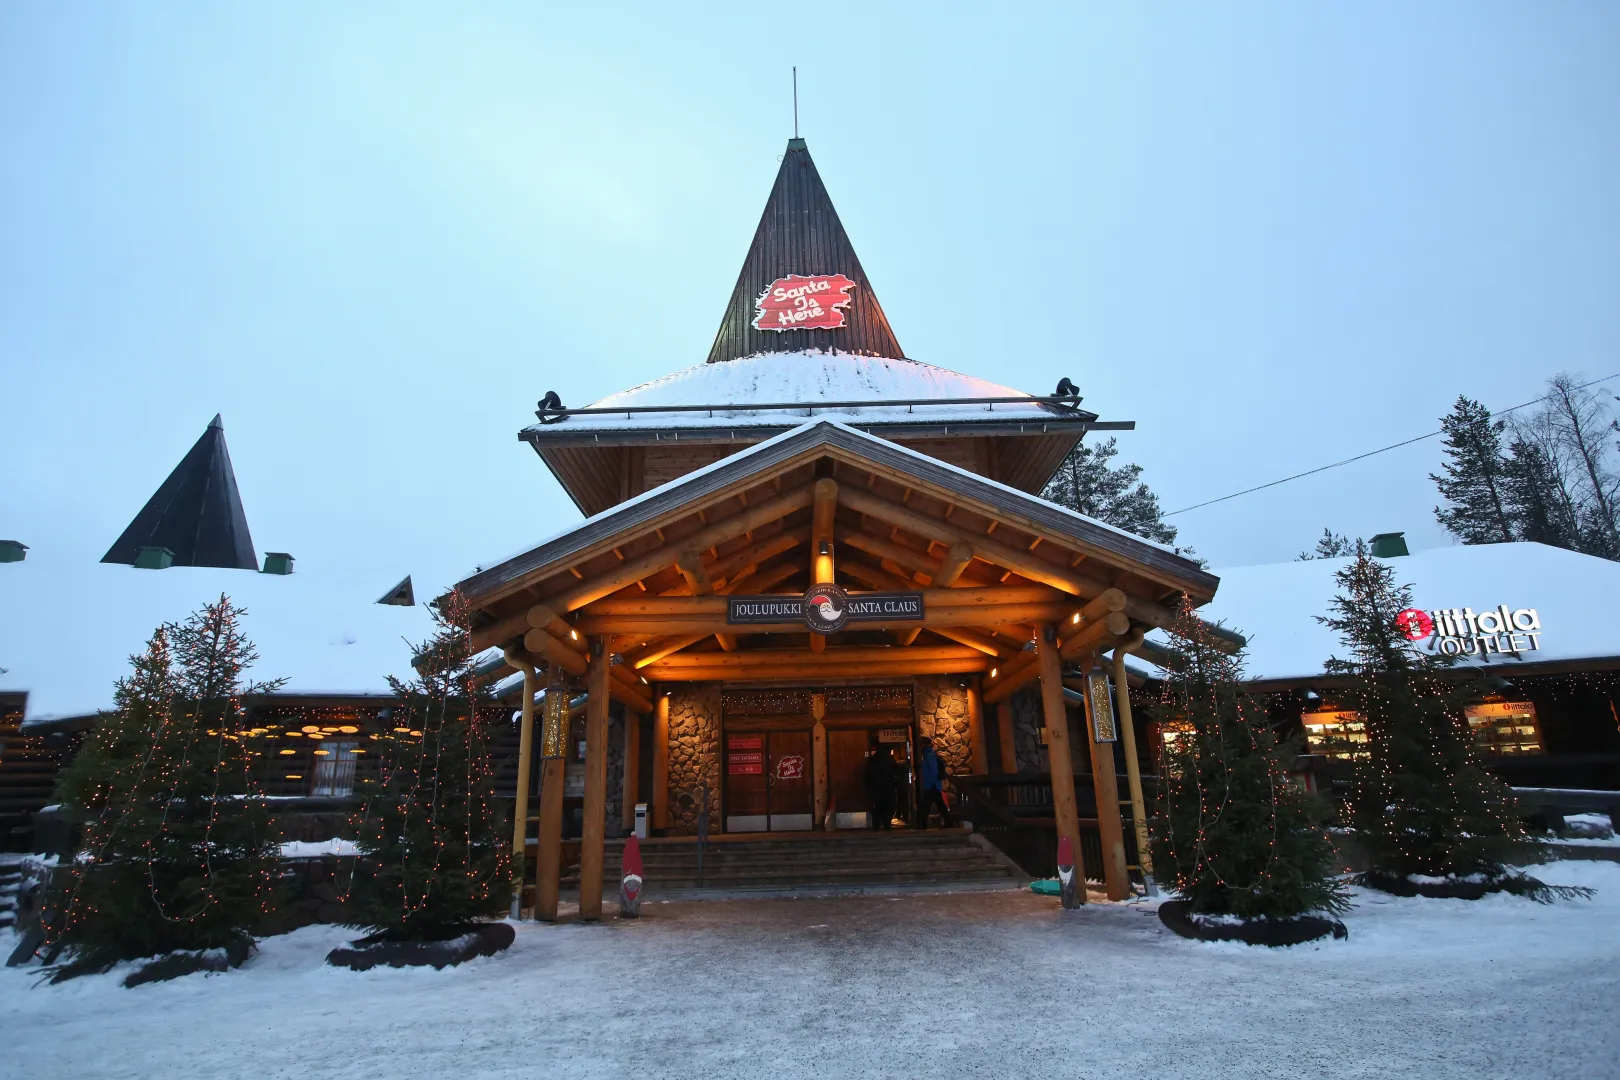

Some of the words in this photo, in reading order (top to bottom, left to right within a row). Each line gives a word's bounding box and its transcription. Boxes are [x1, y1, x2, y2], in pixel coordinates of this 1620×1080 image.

[773, 281, 831, 302] Santa
[794, 296, 820, 311] Is
[778, 306, 825, 326] Here
[735, 603, 802, 617] JOULUPUKKI
[848, 602, 882, 613] SANTA
[884, 601, 918, 612] CLAUS
[1432, 604, 1541, 637] iittala
[1440, 631, 1542, 656] OUTLET
